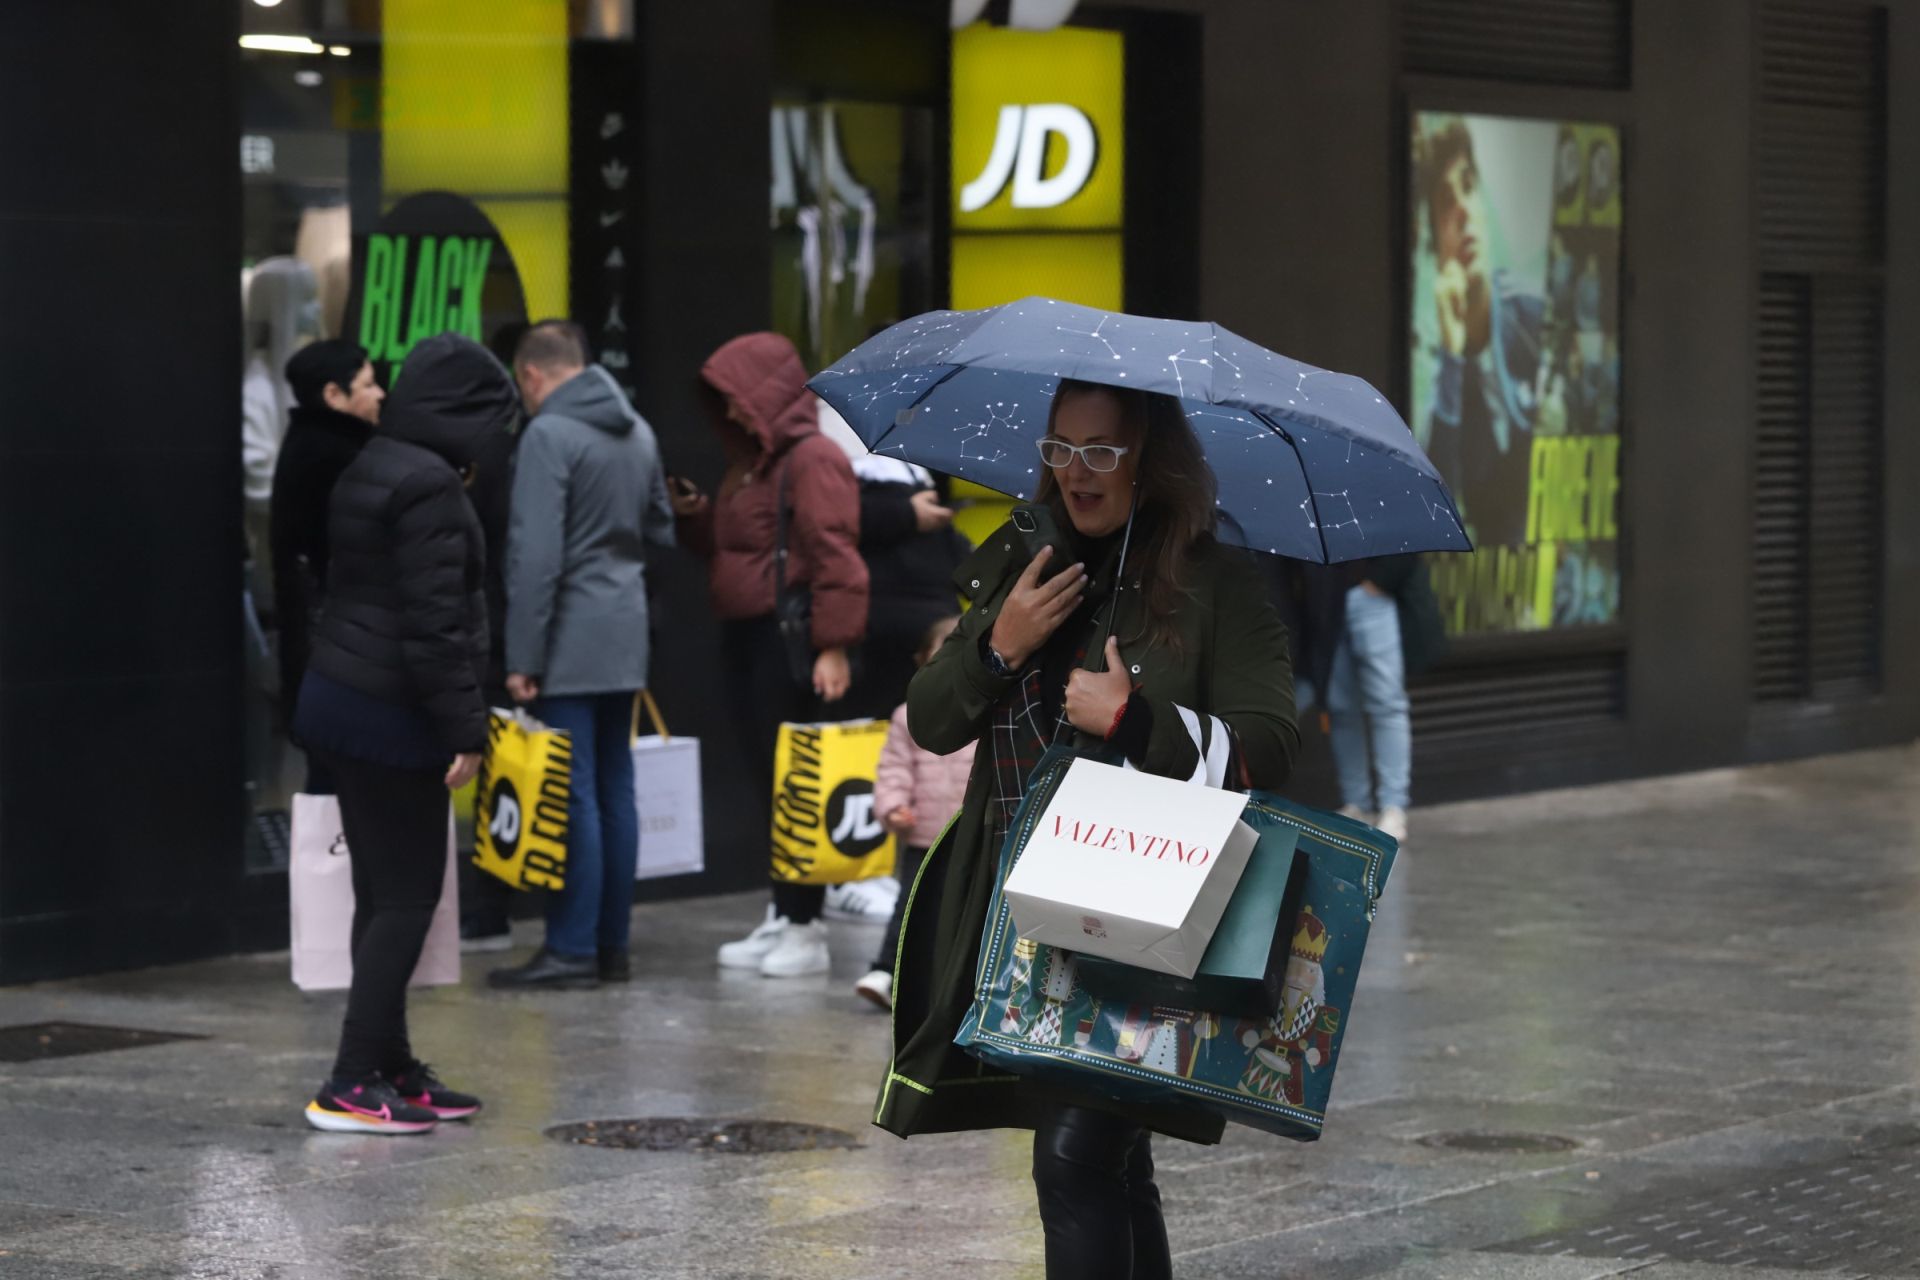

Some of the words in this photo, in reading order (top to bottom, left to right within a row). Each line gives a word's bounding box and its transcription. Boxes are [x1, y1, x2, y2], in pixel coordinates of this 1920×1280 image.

[961, 103, 1098, 212] JD
[358, 233, 493, 361] BLACK
[1054, 815, 1209, 867] VALENTINO
